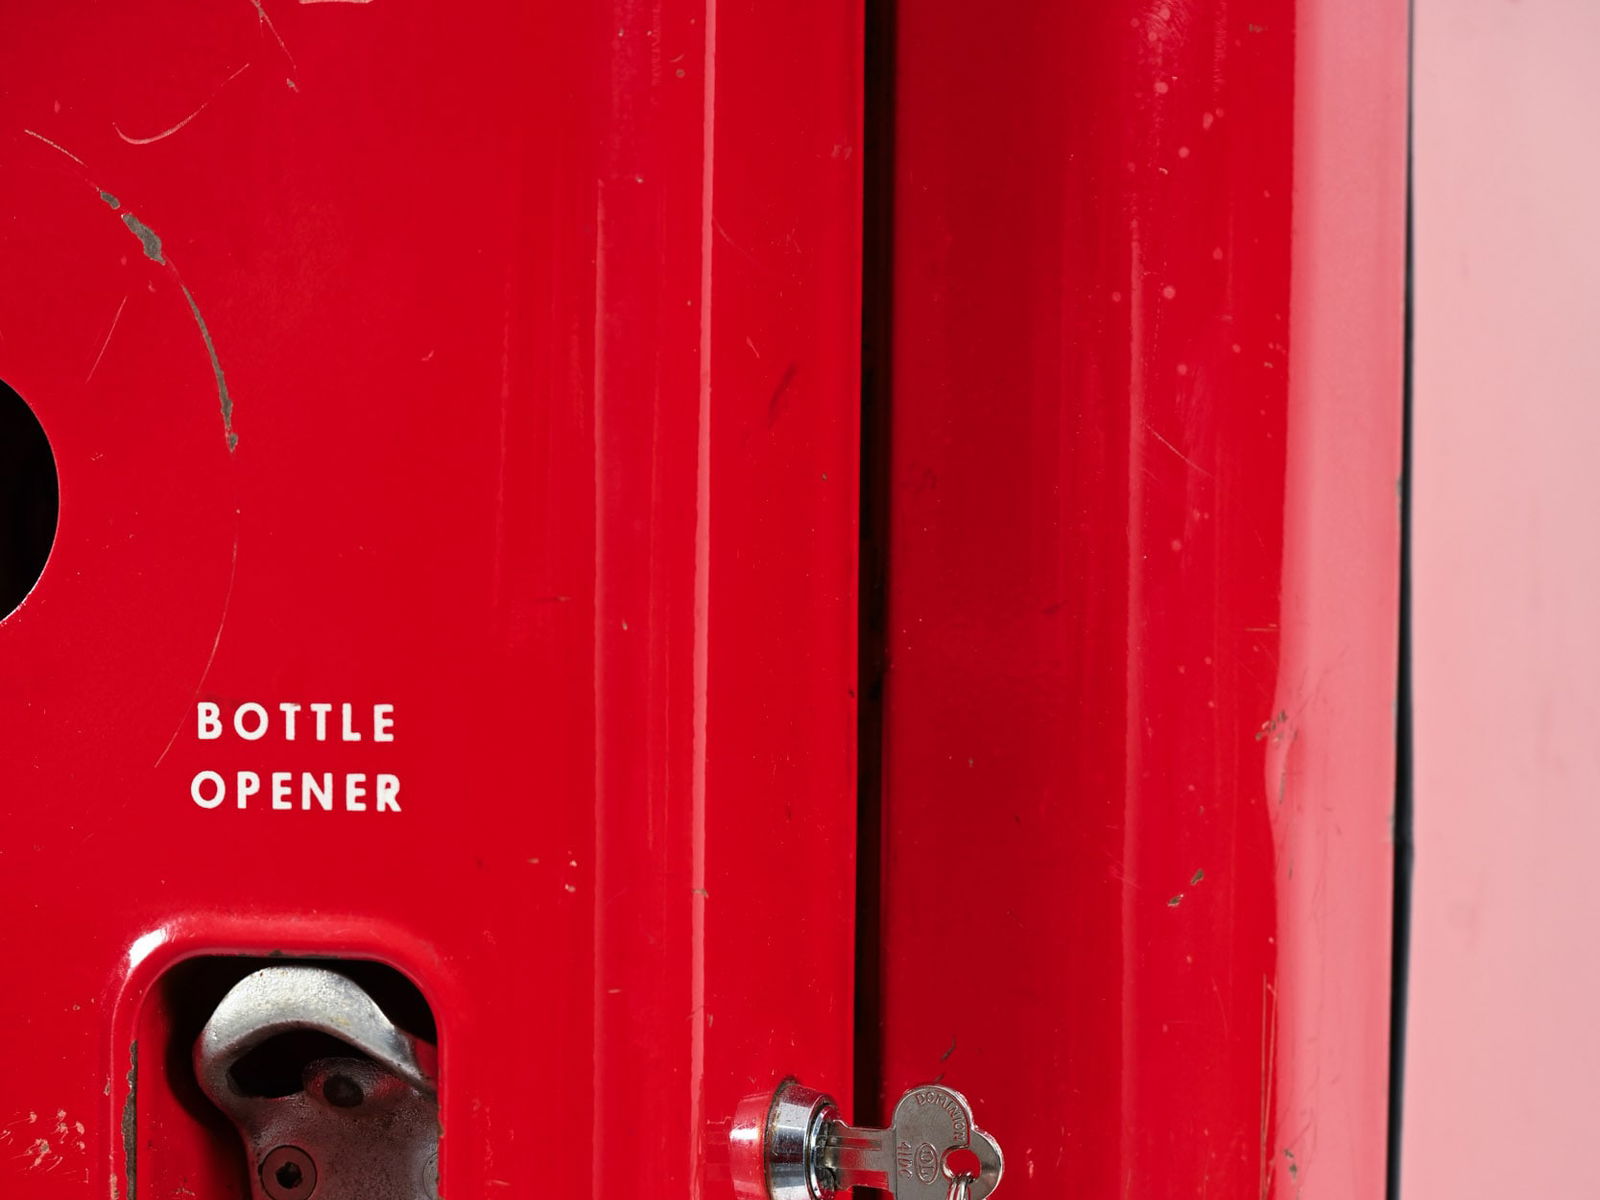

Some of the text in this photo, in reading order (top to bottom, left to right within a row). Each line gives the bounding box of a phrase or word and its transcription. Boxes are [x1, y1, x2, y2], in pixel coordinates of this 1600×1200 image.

[197, 701, 394, 742] BOTTLE
[190, 770, 402, 812] OPENER
[914, 1090, 968, 1144] DOMINION
